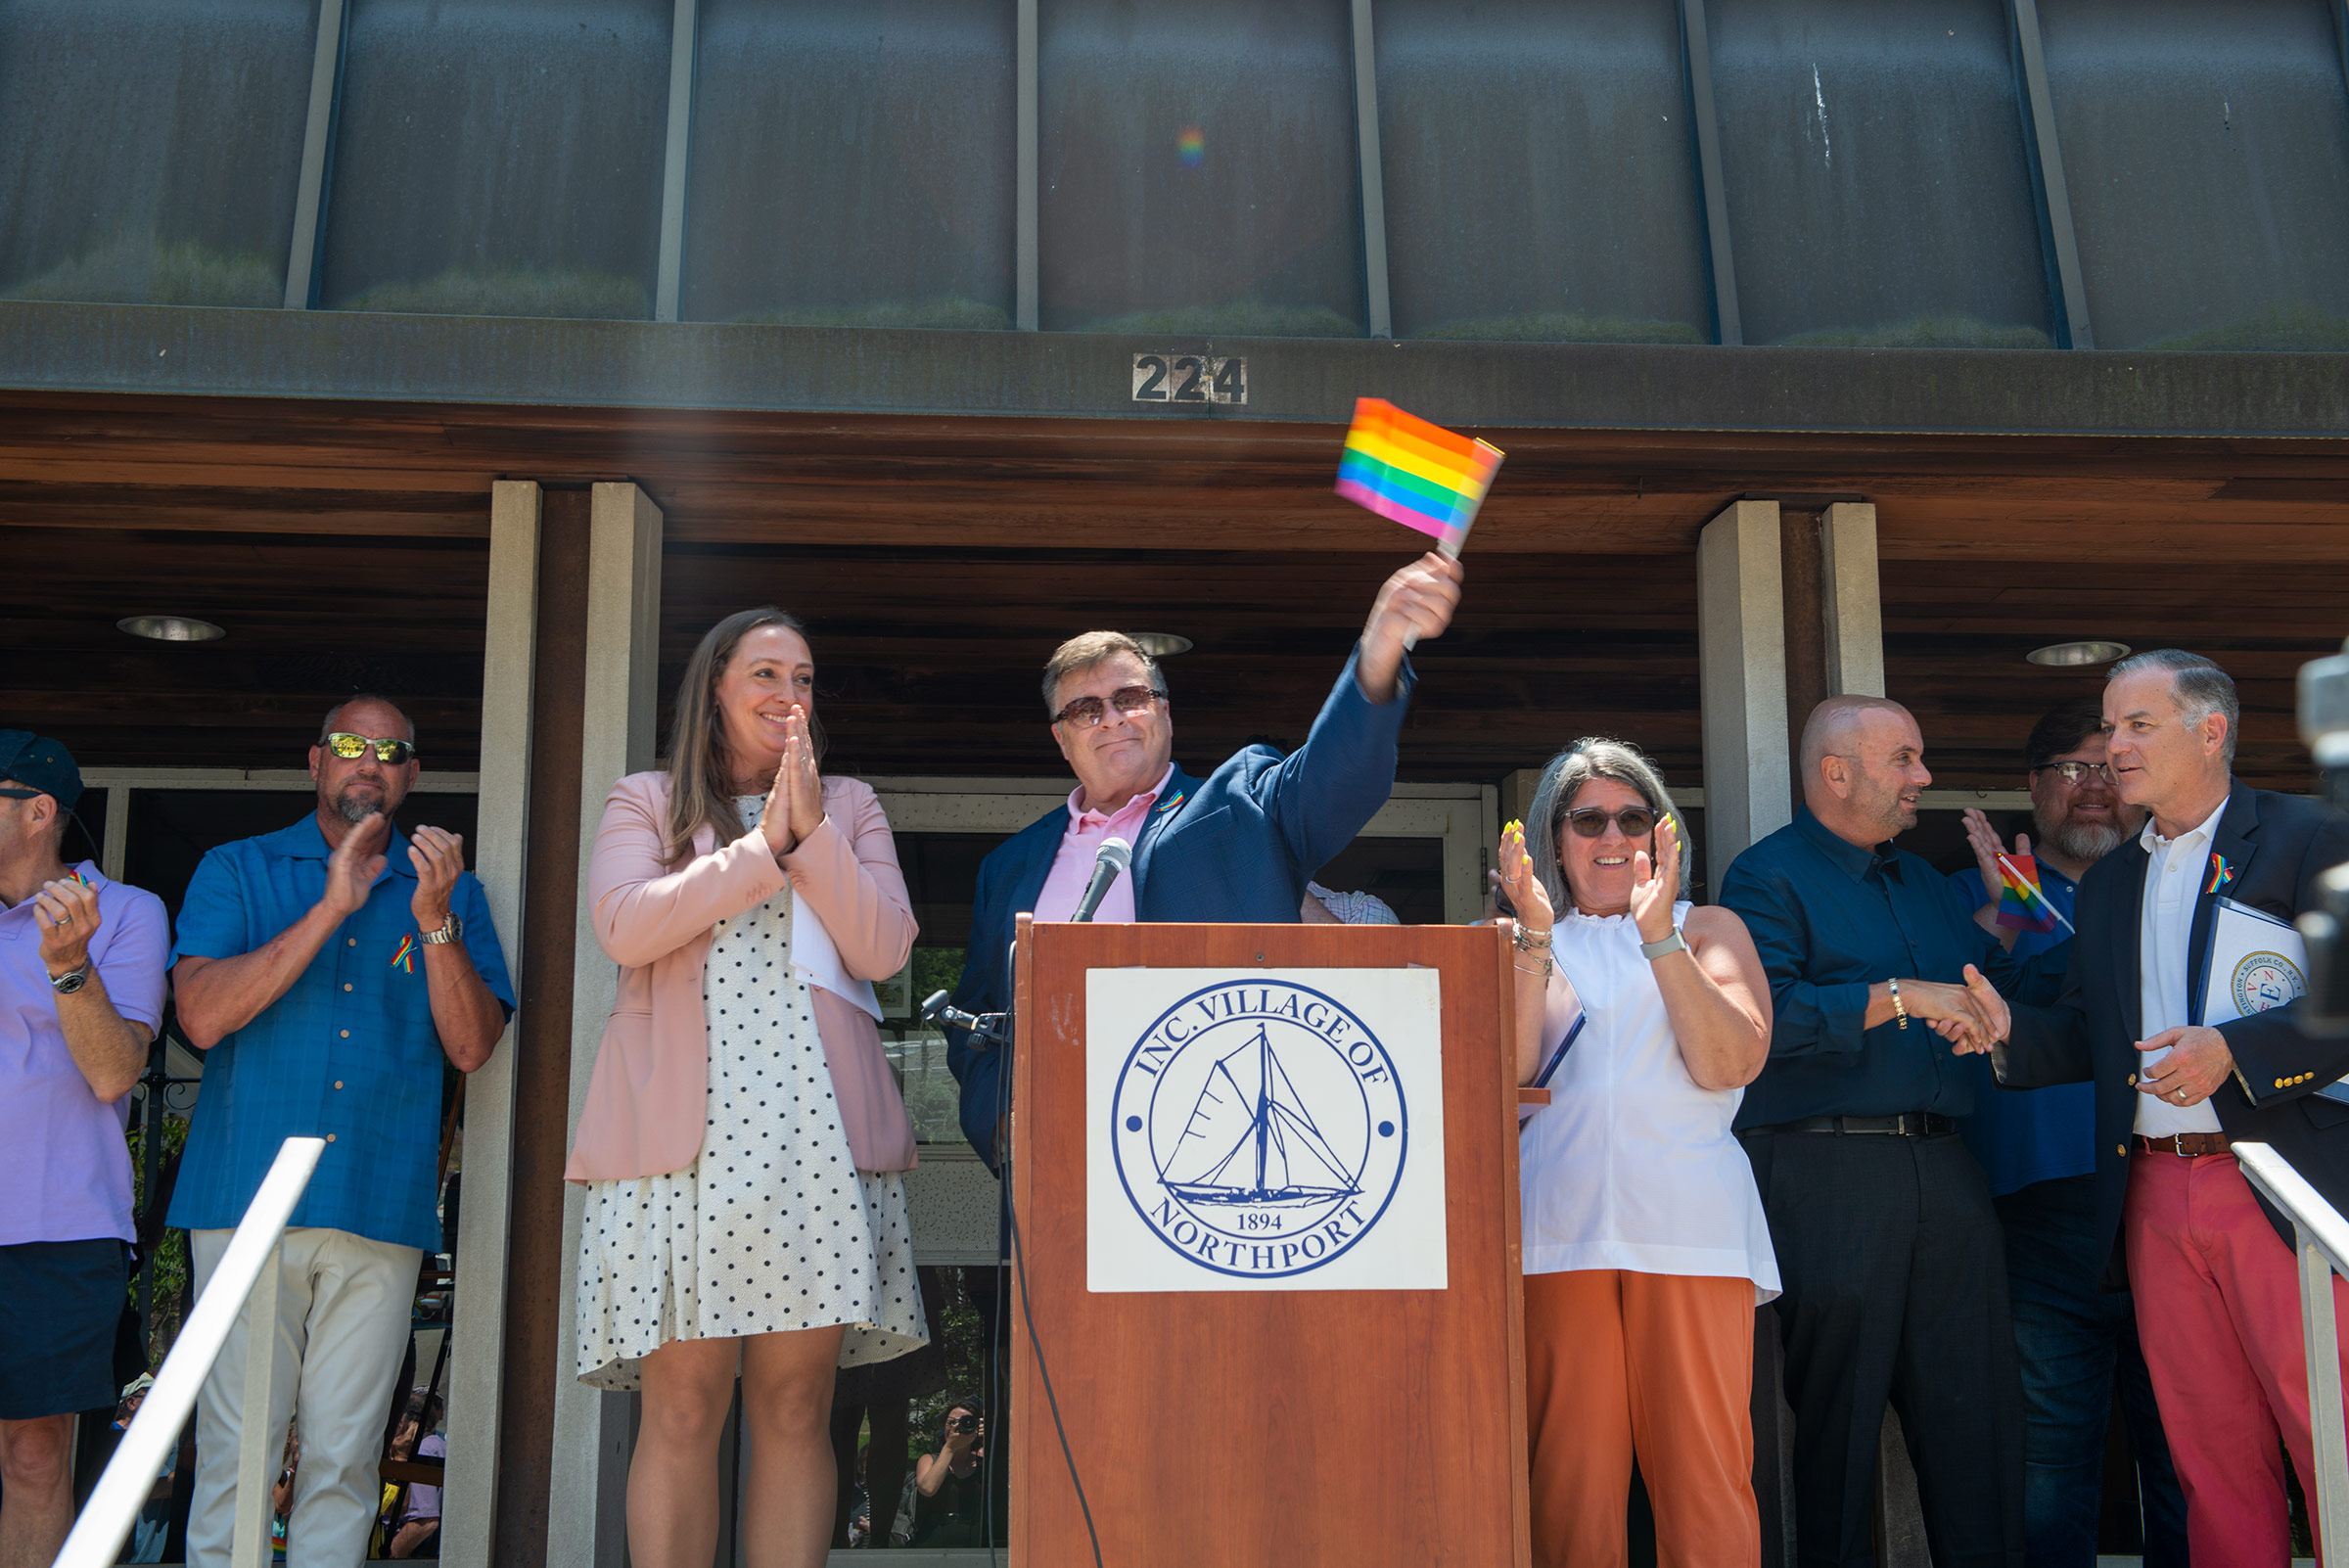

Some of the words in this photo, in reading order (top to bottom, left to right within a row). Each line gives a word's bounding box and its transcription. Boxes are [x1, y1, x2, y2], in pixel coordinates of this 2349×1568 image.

[1135, 355, 1245, 402] 224
[2243, 957, 2272, 972] SUFFOLK
[2236, 978, 2253, 1014] NTINGTON
[1133, 1015, 1200, 1079] INC.
[1195, 989, 1351, 1044] VILLAGE
[1348, 1041, 1389, 1086] OF
[1150, 1196, 1366, 1269] NORTHPORT
[1236, 1213, 1283, 1231] 1894
